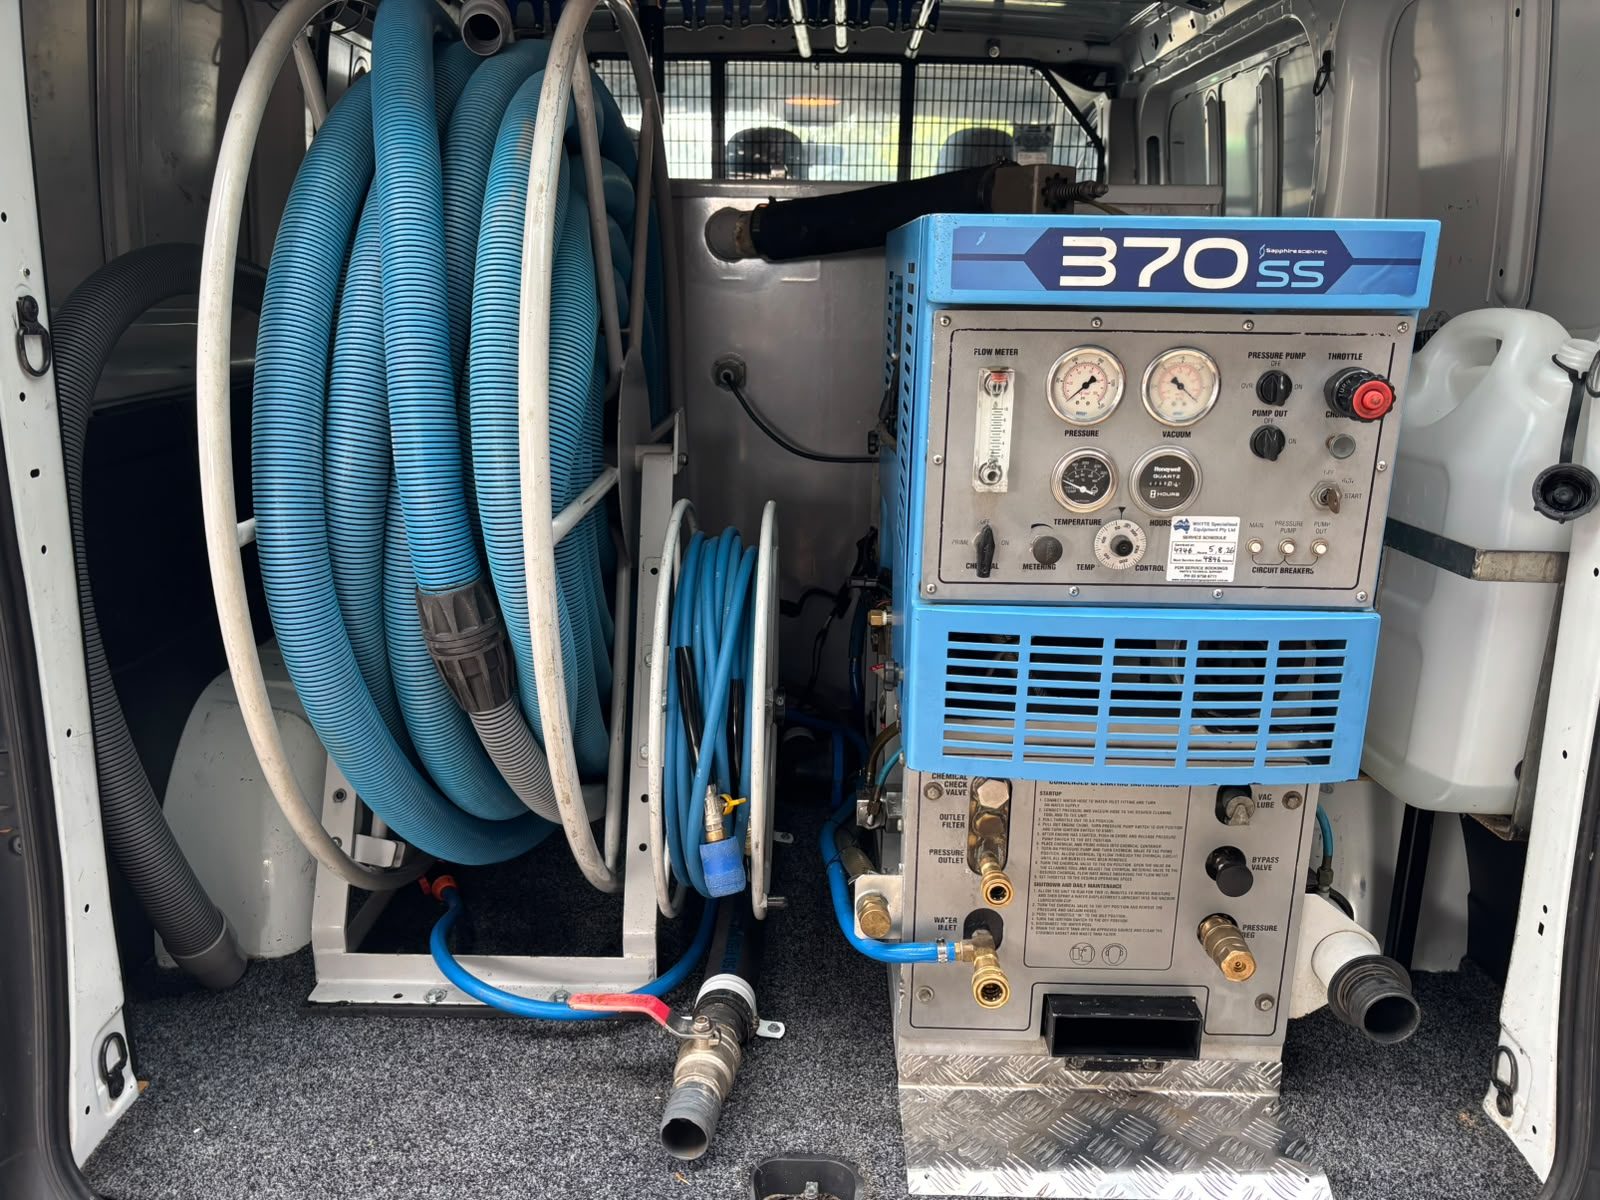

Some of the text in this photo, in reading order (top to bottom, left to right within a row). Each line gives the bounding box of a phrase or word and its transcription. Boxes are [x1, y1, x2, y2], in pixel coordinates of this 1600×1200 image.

[1266, 247, 1297, 255] Sapphire
[1059, 236, 1249, 289] 370
[1256, 260, 1325, 288] SS
[974, 348, 1019, 356] FLOW METER
[1248, 351, 1306, 360] PRESSURE PUMP
[1328, 352, 1364, 360] THROTTLE
[1274, 410, 1288, 418] OUT
[1064, 430, 1100, 438] PRESSURE
[1162, 431, 1192, 439] VACUUM
[1022, 563, 1056, 571] METERING
[932, 772, 968, 780] CHEMICAL
